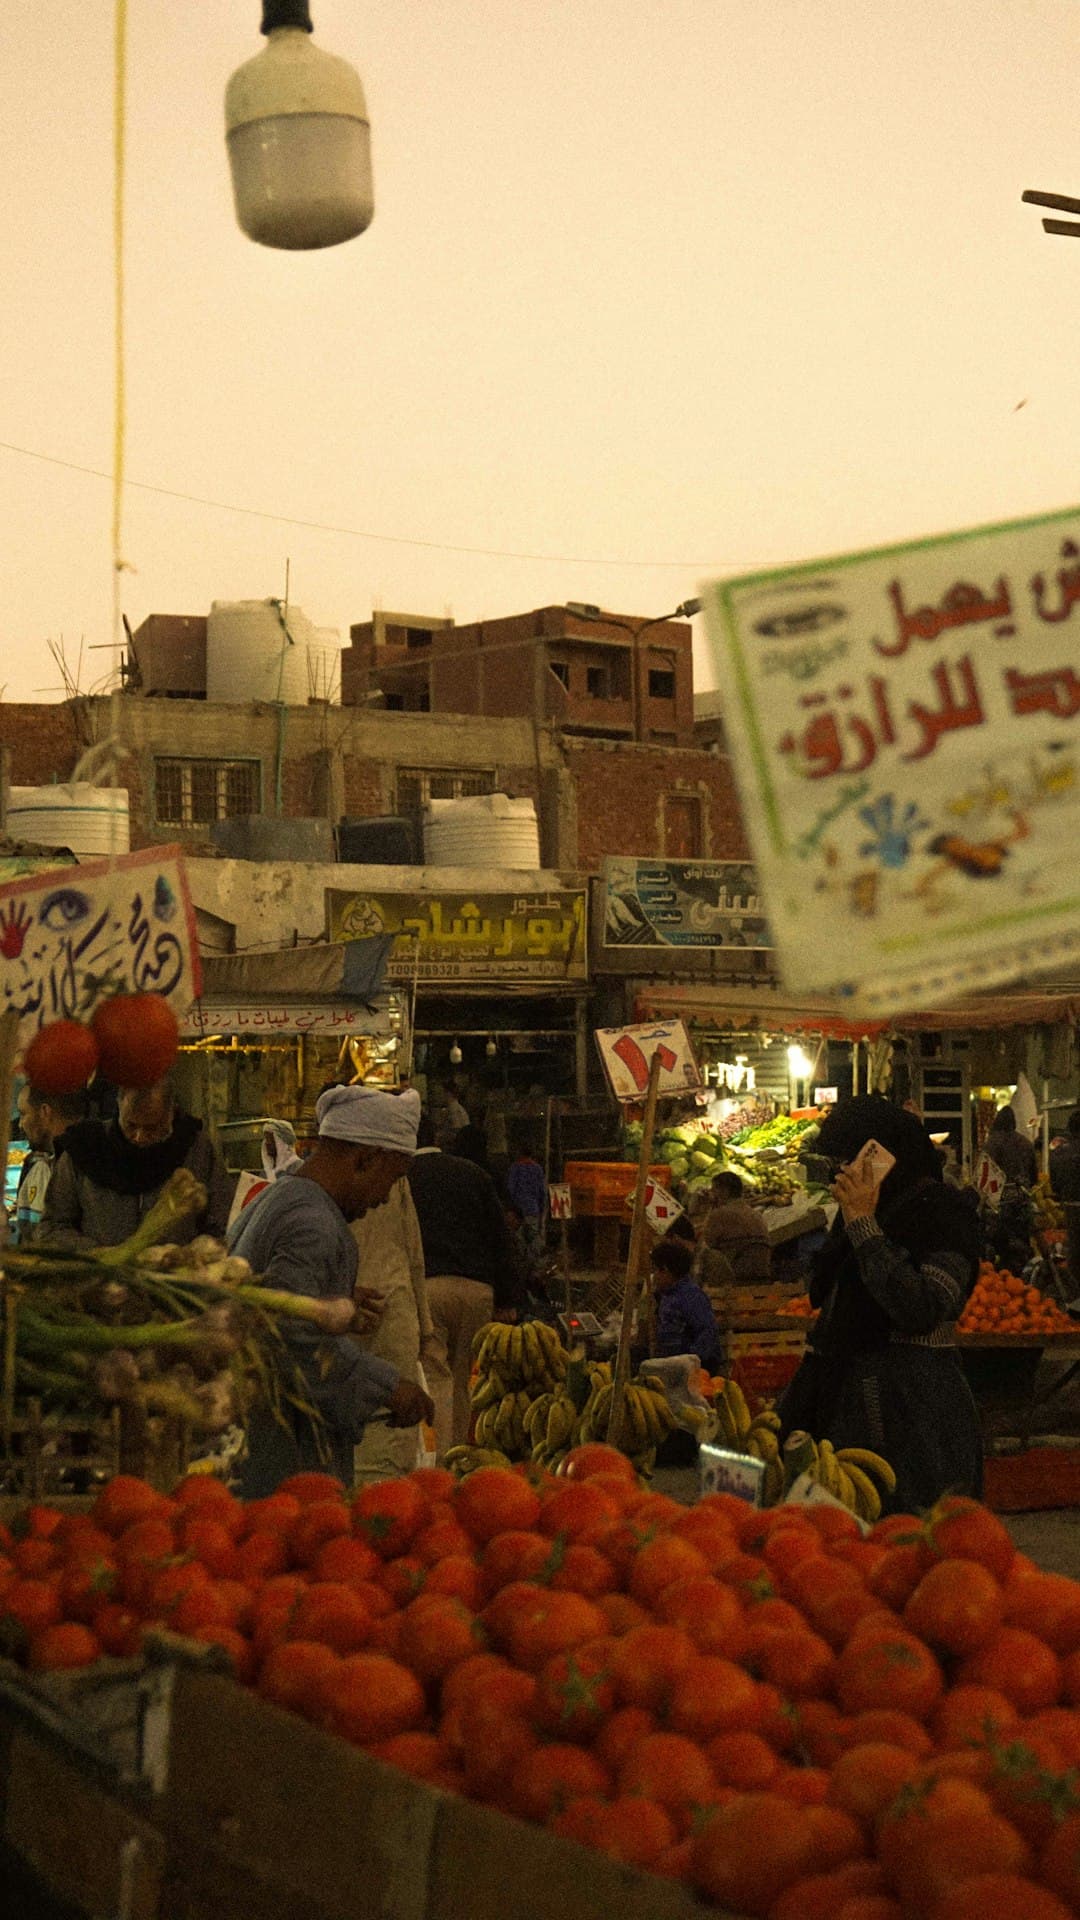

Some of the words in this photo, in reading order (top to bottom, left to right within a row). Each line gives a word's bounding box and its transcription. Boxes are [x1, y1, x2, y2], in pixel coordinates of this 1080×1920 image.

[510, 894, 562, 916] طيور
[399, 901, 512, 956] رشاد
[253, 1009, 290, 1029] طيبات
[295, 1011, 325, 1028] من
[325, 1009, 357, 1027] كلوا
